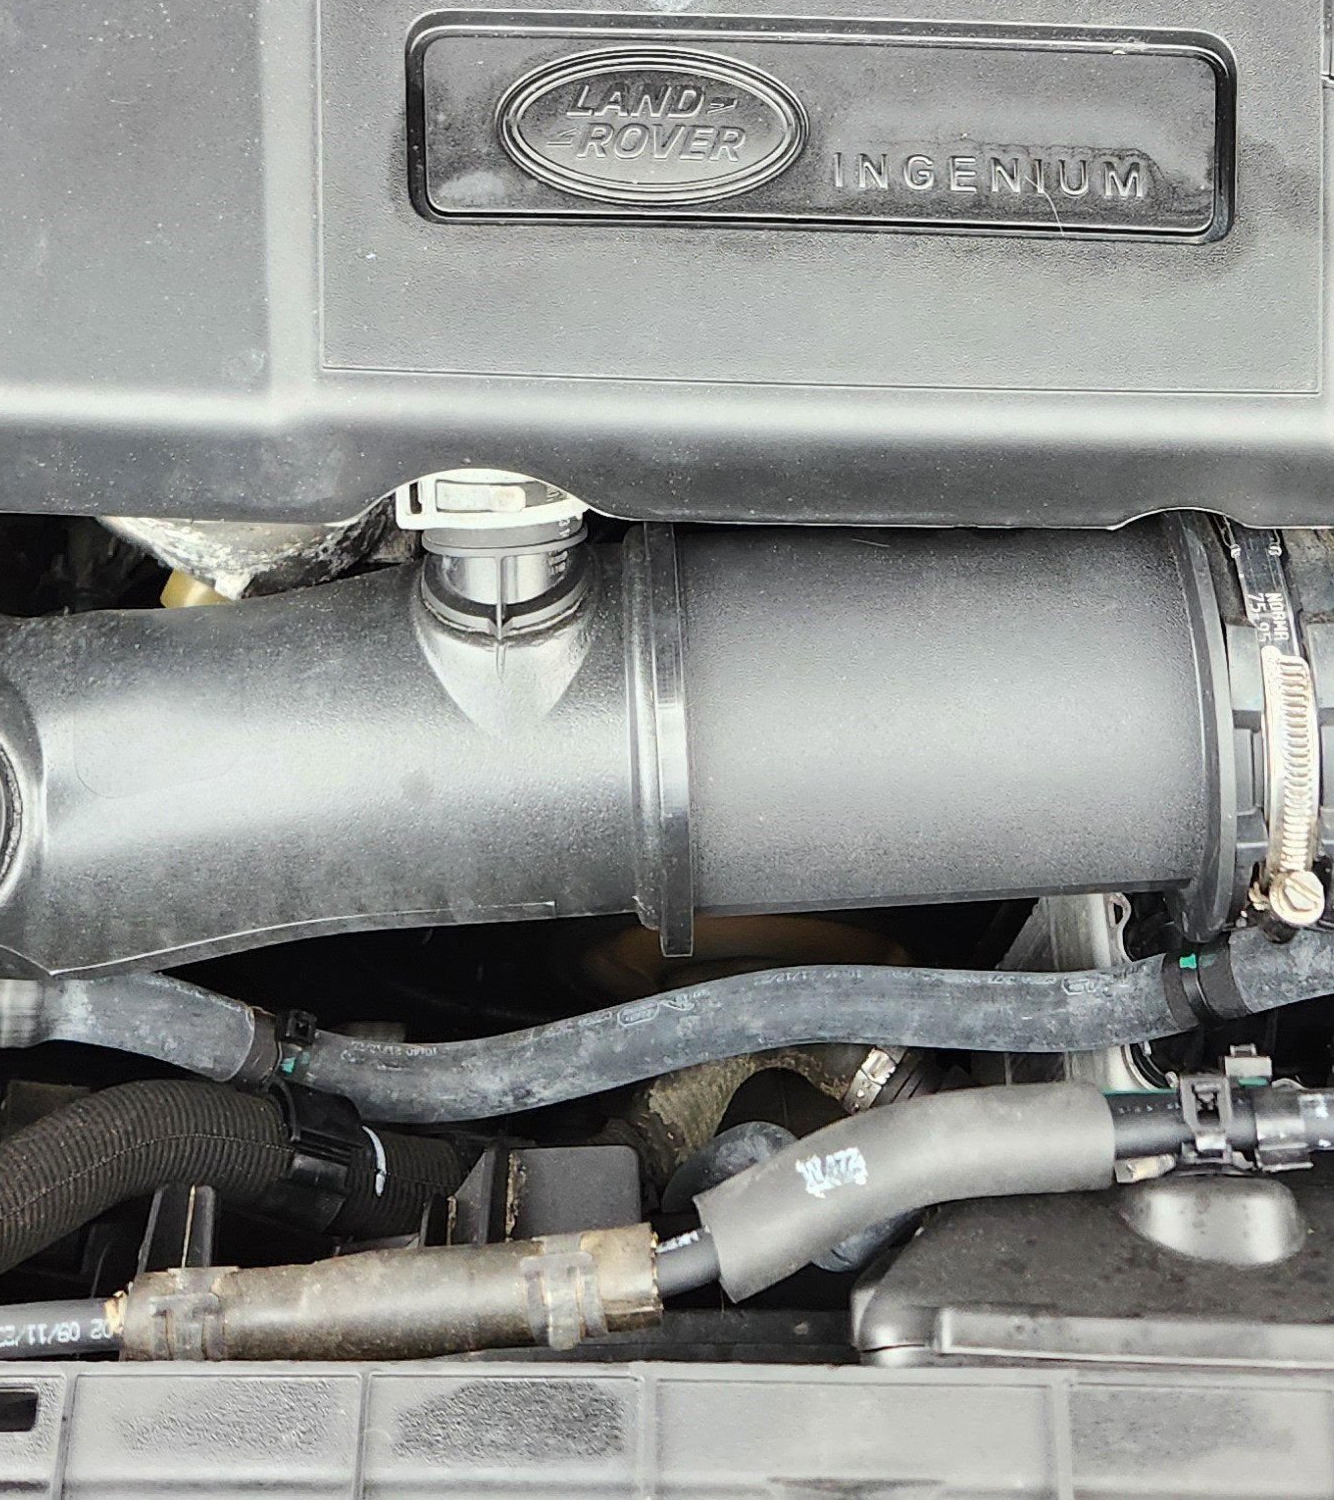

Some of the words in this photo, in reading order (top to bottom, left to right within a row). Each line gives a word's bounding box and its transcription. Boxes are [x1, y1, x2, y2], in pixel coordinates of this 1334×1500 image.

[565, 82, 709, 120] LAND
[576, 124, 748, 163] ROVER
[830, 151, 1148, 199] INGENIUM
[1264, 592, 1290, 641] NORMA
